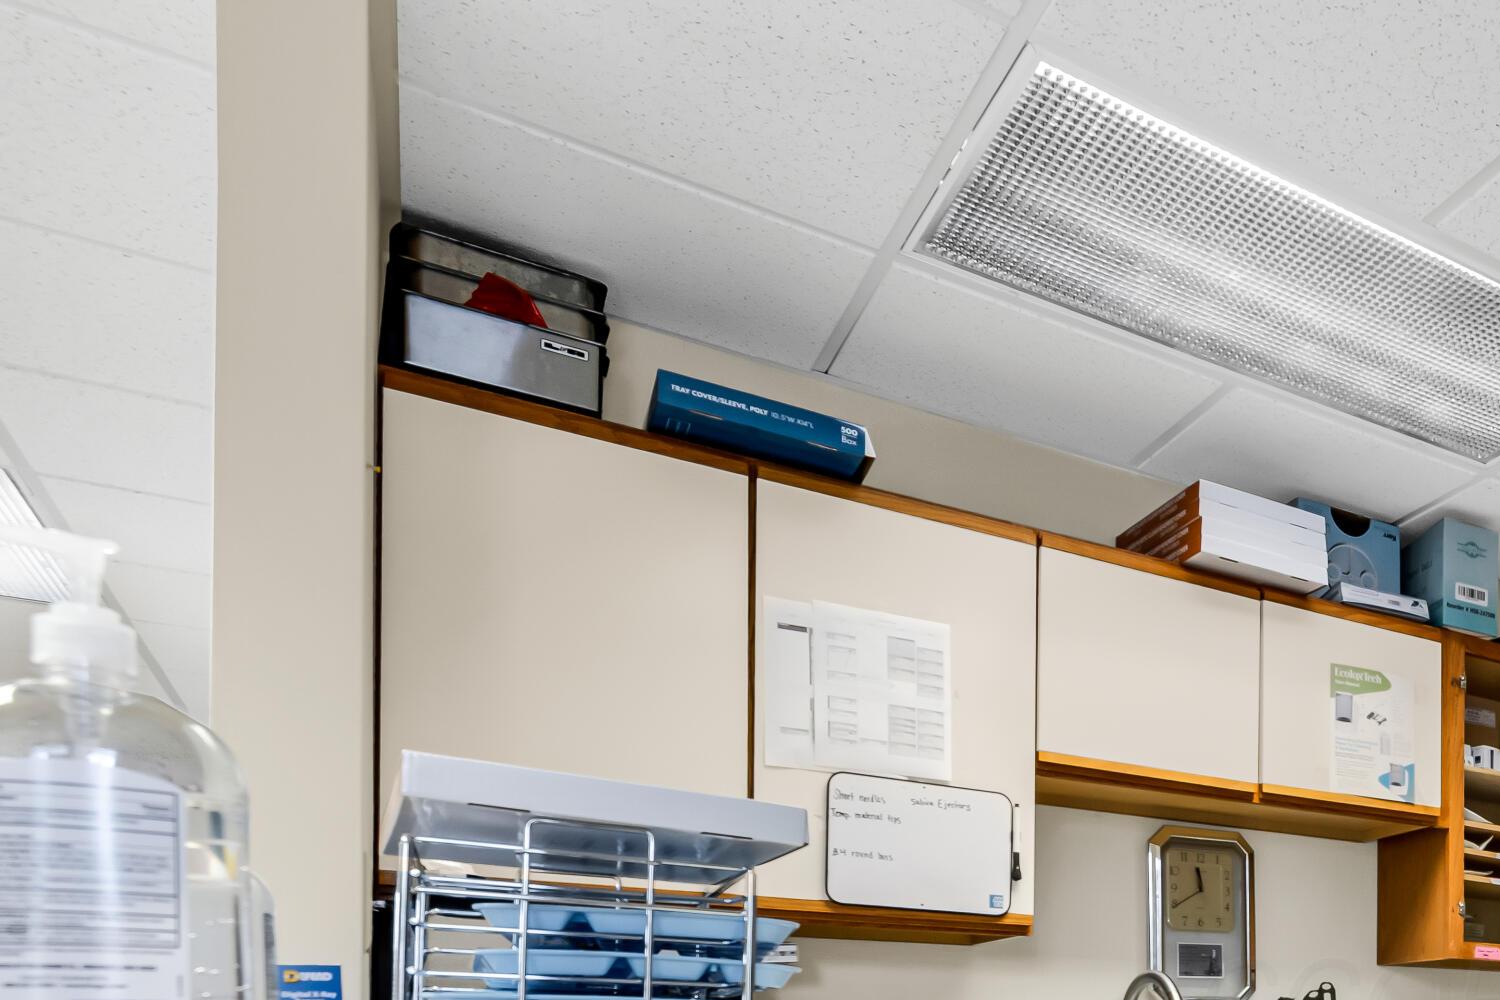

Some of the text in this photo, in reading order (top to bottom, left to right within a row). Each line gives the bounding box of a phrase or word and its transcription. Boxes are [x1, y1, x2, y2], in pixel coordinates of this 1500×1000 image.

[670, 383, 691, 395] TRAY
[840, 426, 858, 437] 500
[841, 435, 857, 446] Box
[1180, 852, 1188, 863] 11
[1196, 853, 1206, 863] 12
[1223, 870, 1231, 881] 2
[1171, 884, 1231, 896] 9 3
[1223, 902, 1230, 912] 4
[1181, 916, 1222, 928] 7 6 5
